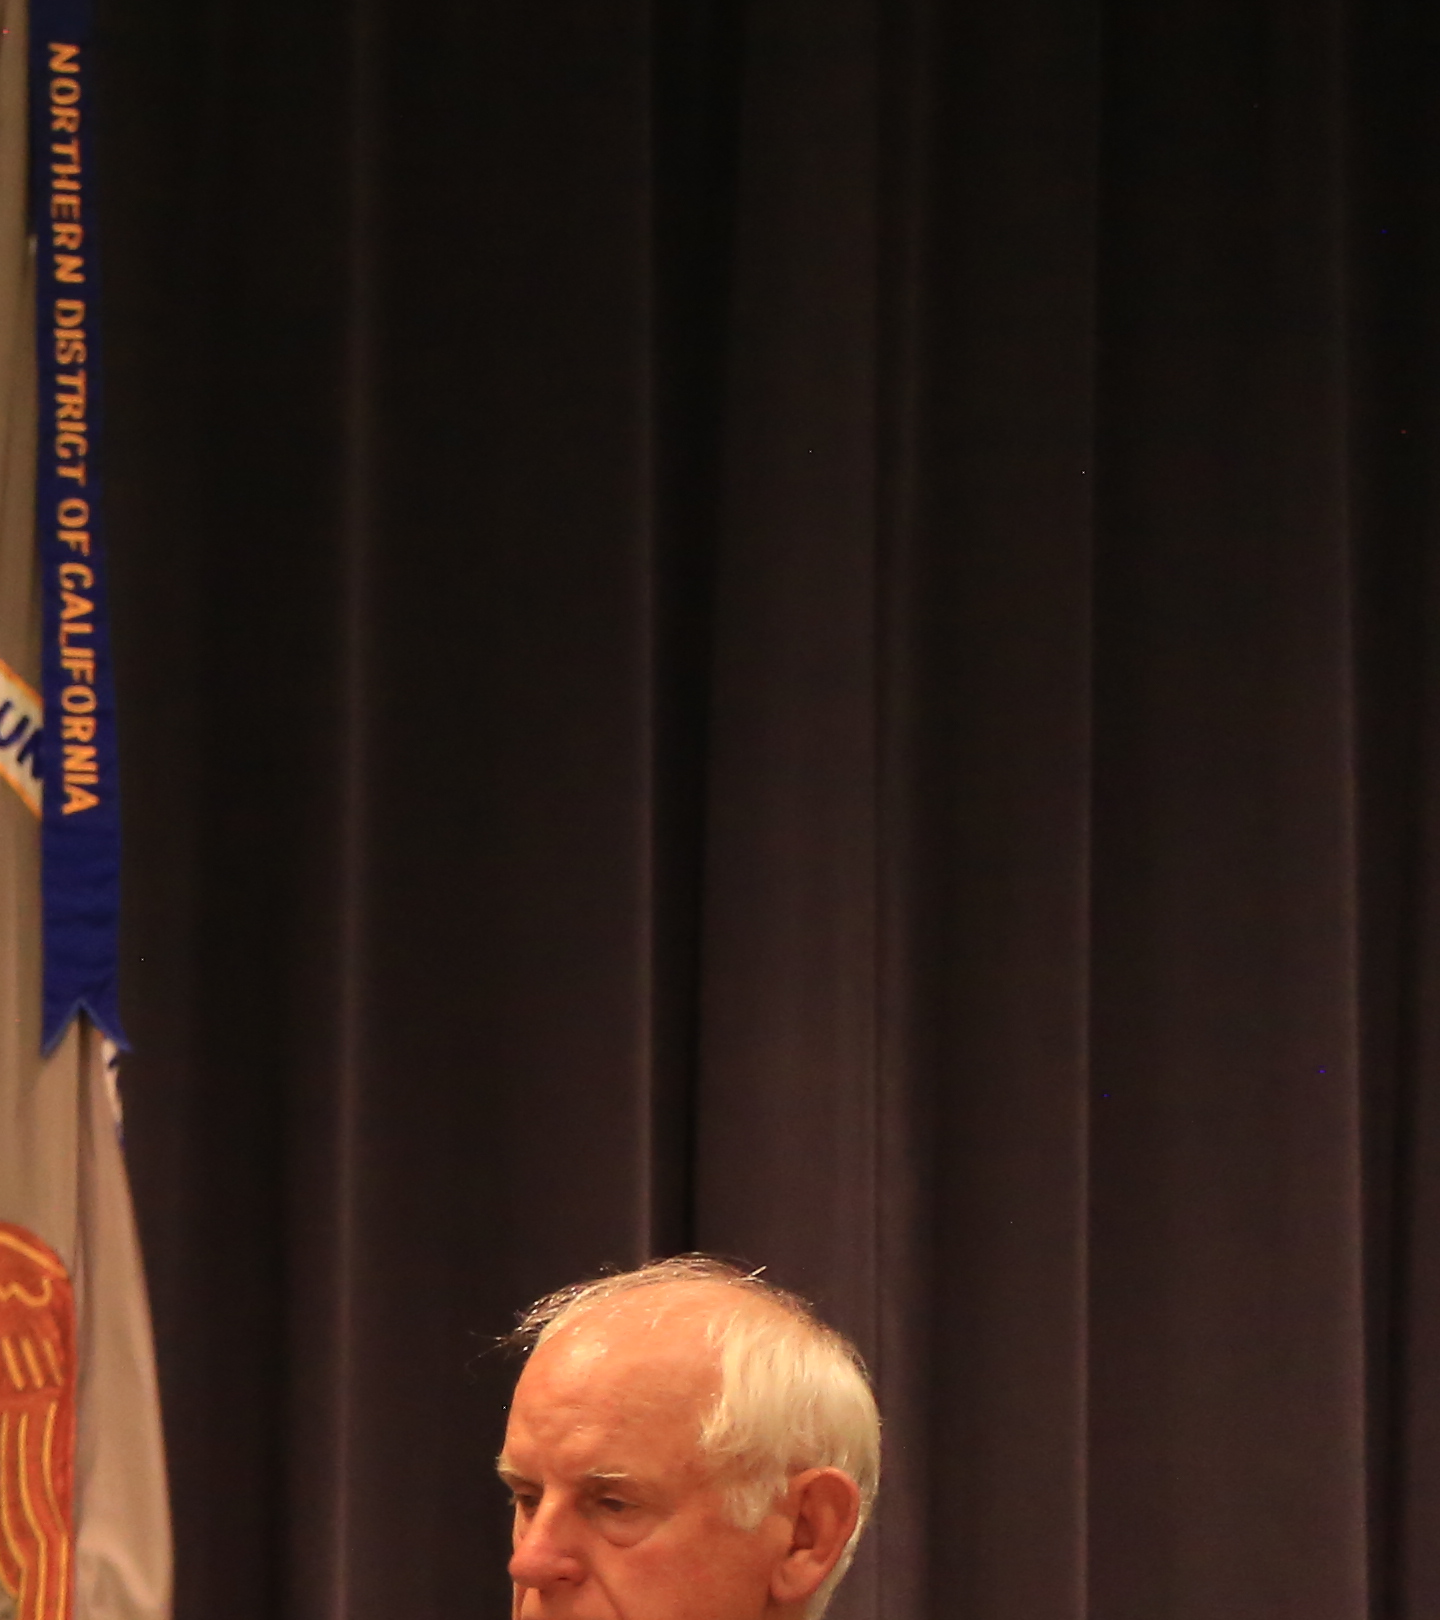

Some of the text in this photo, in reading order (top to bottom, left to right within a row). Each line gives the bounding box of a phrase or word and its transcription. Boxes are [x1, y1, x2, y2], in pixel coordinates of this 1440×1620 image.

[46, 42, 100, 817] NORTHERN DISTRICT OF CALIFORNIA
